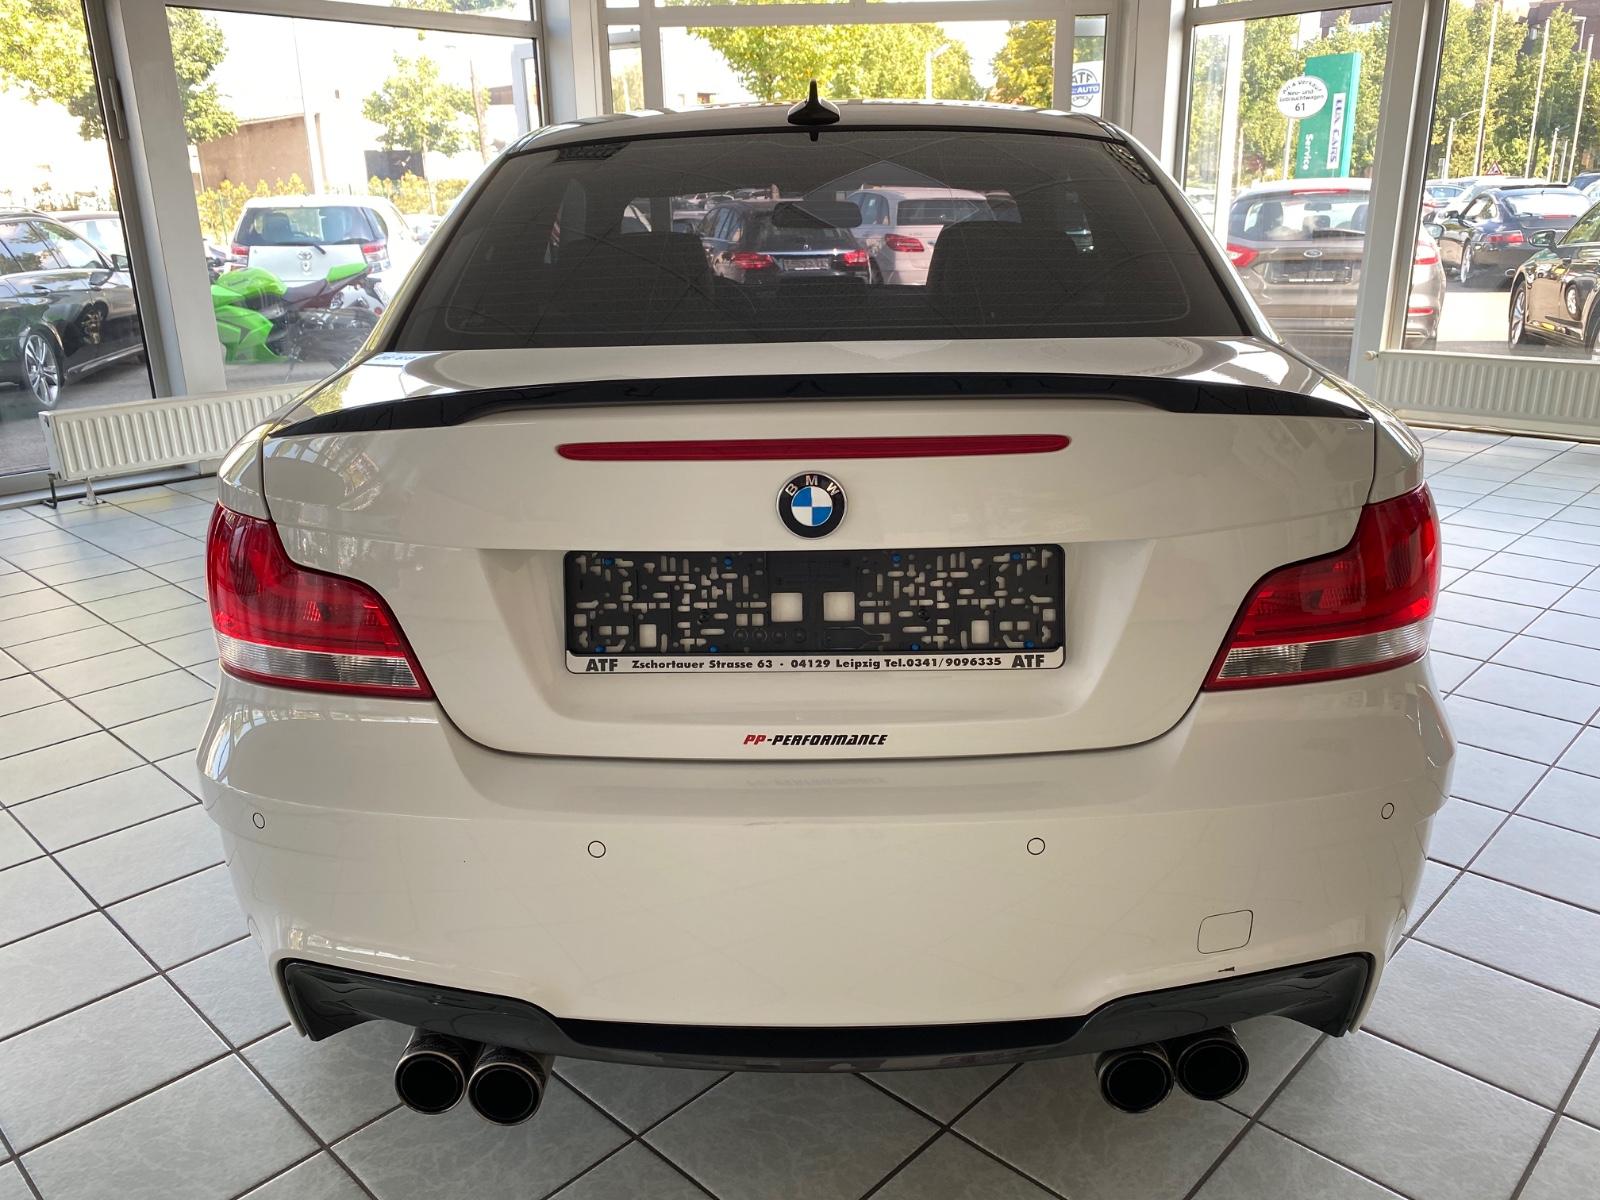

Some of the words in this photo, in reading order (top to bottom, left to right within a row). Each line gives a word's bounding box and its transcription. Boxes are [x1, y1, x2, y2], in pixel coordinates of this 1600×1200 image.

[1295, 102, 1306, 112] 61
[1303, 133, 1314, 170] Service
[1330, 129, 1340, 163] CARS
[785, 475, 840, 497] BMW
[585, 658, 619, 672] ATF
[631, 659, 705, 669] Zschortauer
[708, 659, 753, 669] Strasse
[757, 659, 773, 669] 63
[790, 658, 831, 668] 04129
[835, 657, 881, 670] Leipzig
[884, 656, 1002, 668] Tel.0341/9096335
[1011, 654, 1045, 668] ATF
[743, 734, 888, 746] PP-PERFORMANCE
